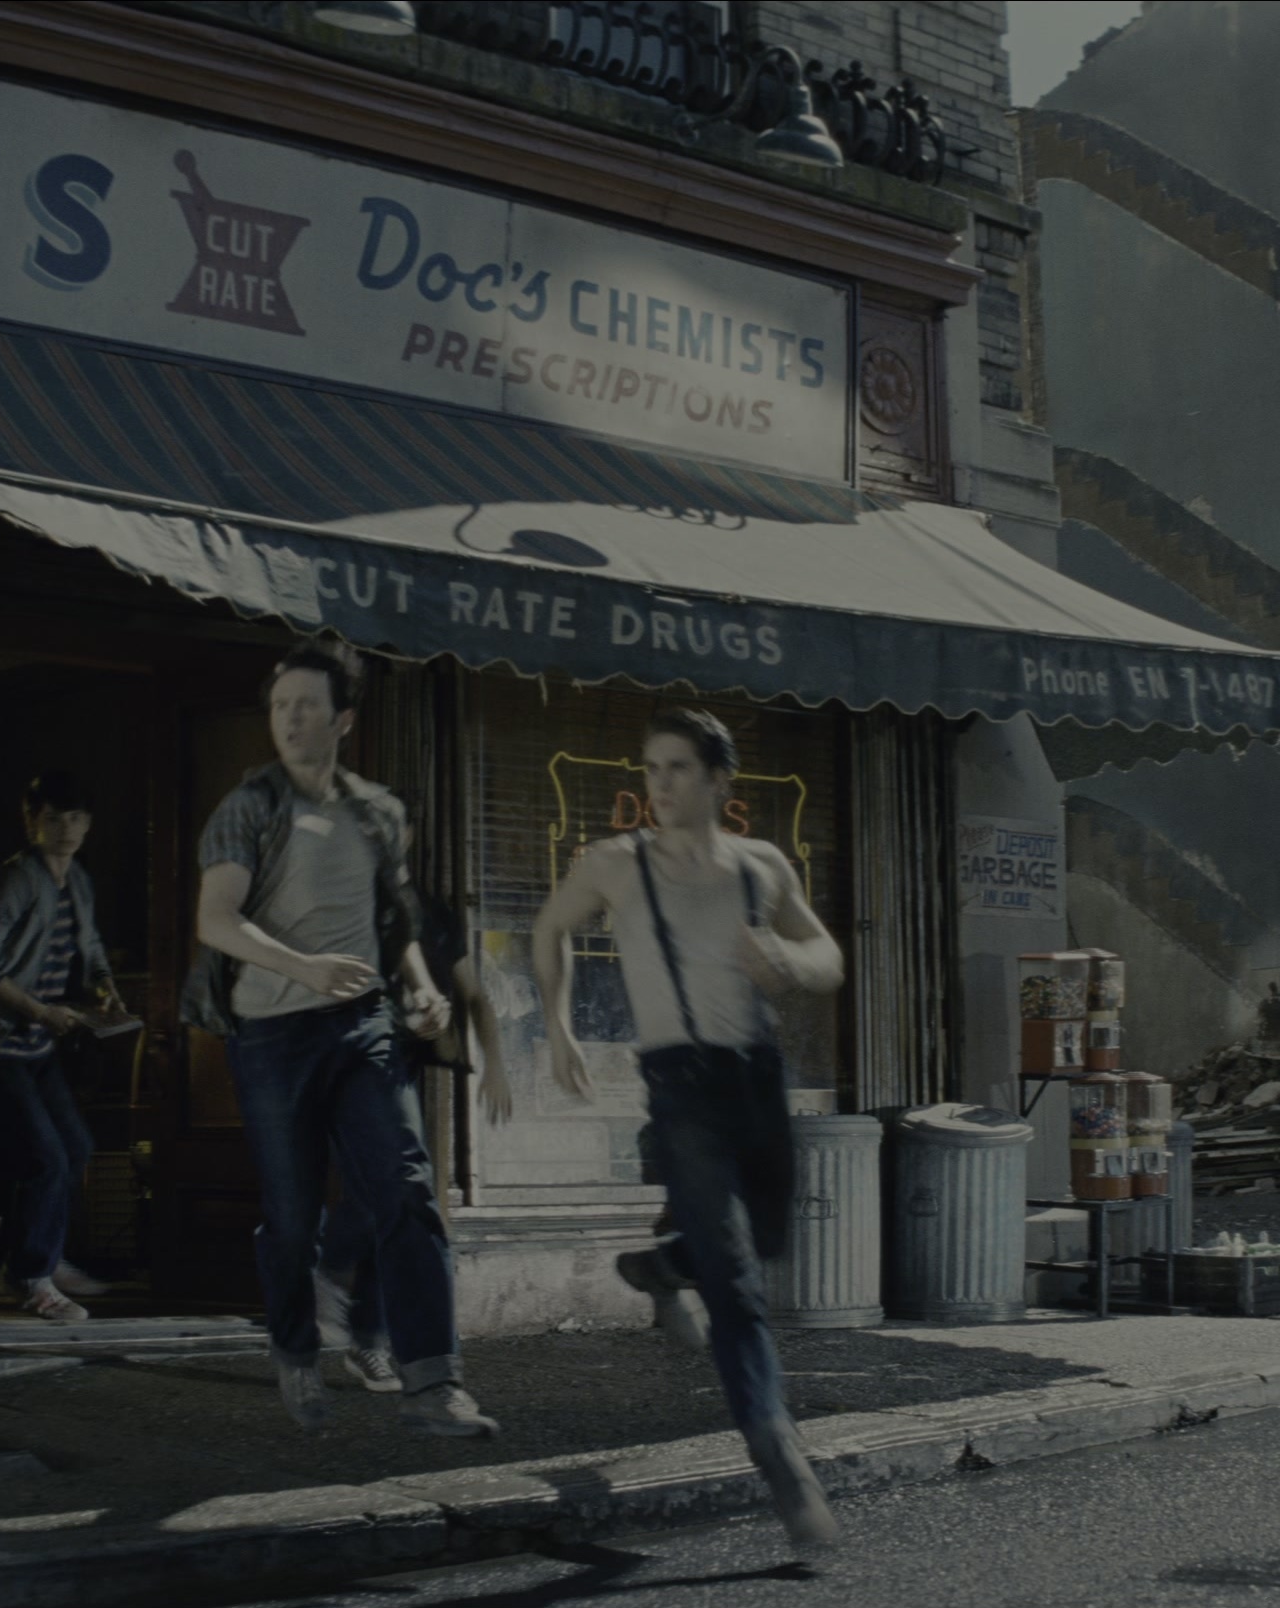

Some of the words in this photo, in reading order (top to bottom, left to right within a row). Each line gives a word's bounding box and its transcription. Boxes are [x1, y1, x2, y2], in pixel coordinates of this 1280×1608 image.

[205, 215, 275, 260] CUT
[198, 268, 277, 317] RATE
[357, 197, 549, 321] Doc's
[569, 279, 825, 389] CHEMISTS
[400, 323, 775, 435] PRESCRIPTIONS
[314, 556, 415, 615] CUT
[448, 581, 578, 640] RATE
[610, 605, 784, 666] DRUGS
[1021, 657, 1110, 697] Phone
[1127, 666, 1170, 700] EN
[996, 829, 1057, 859] DEPOSIT
